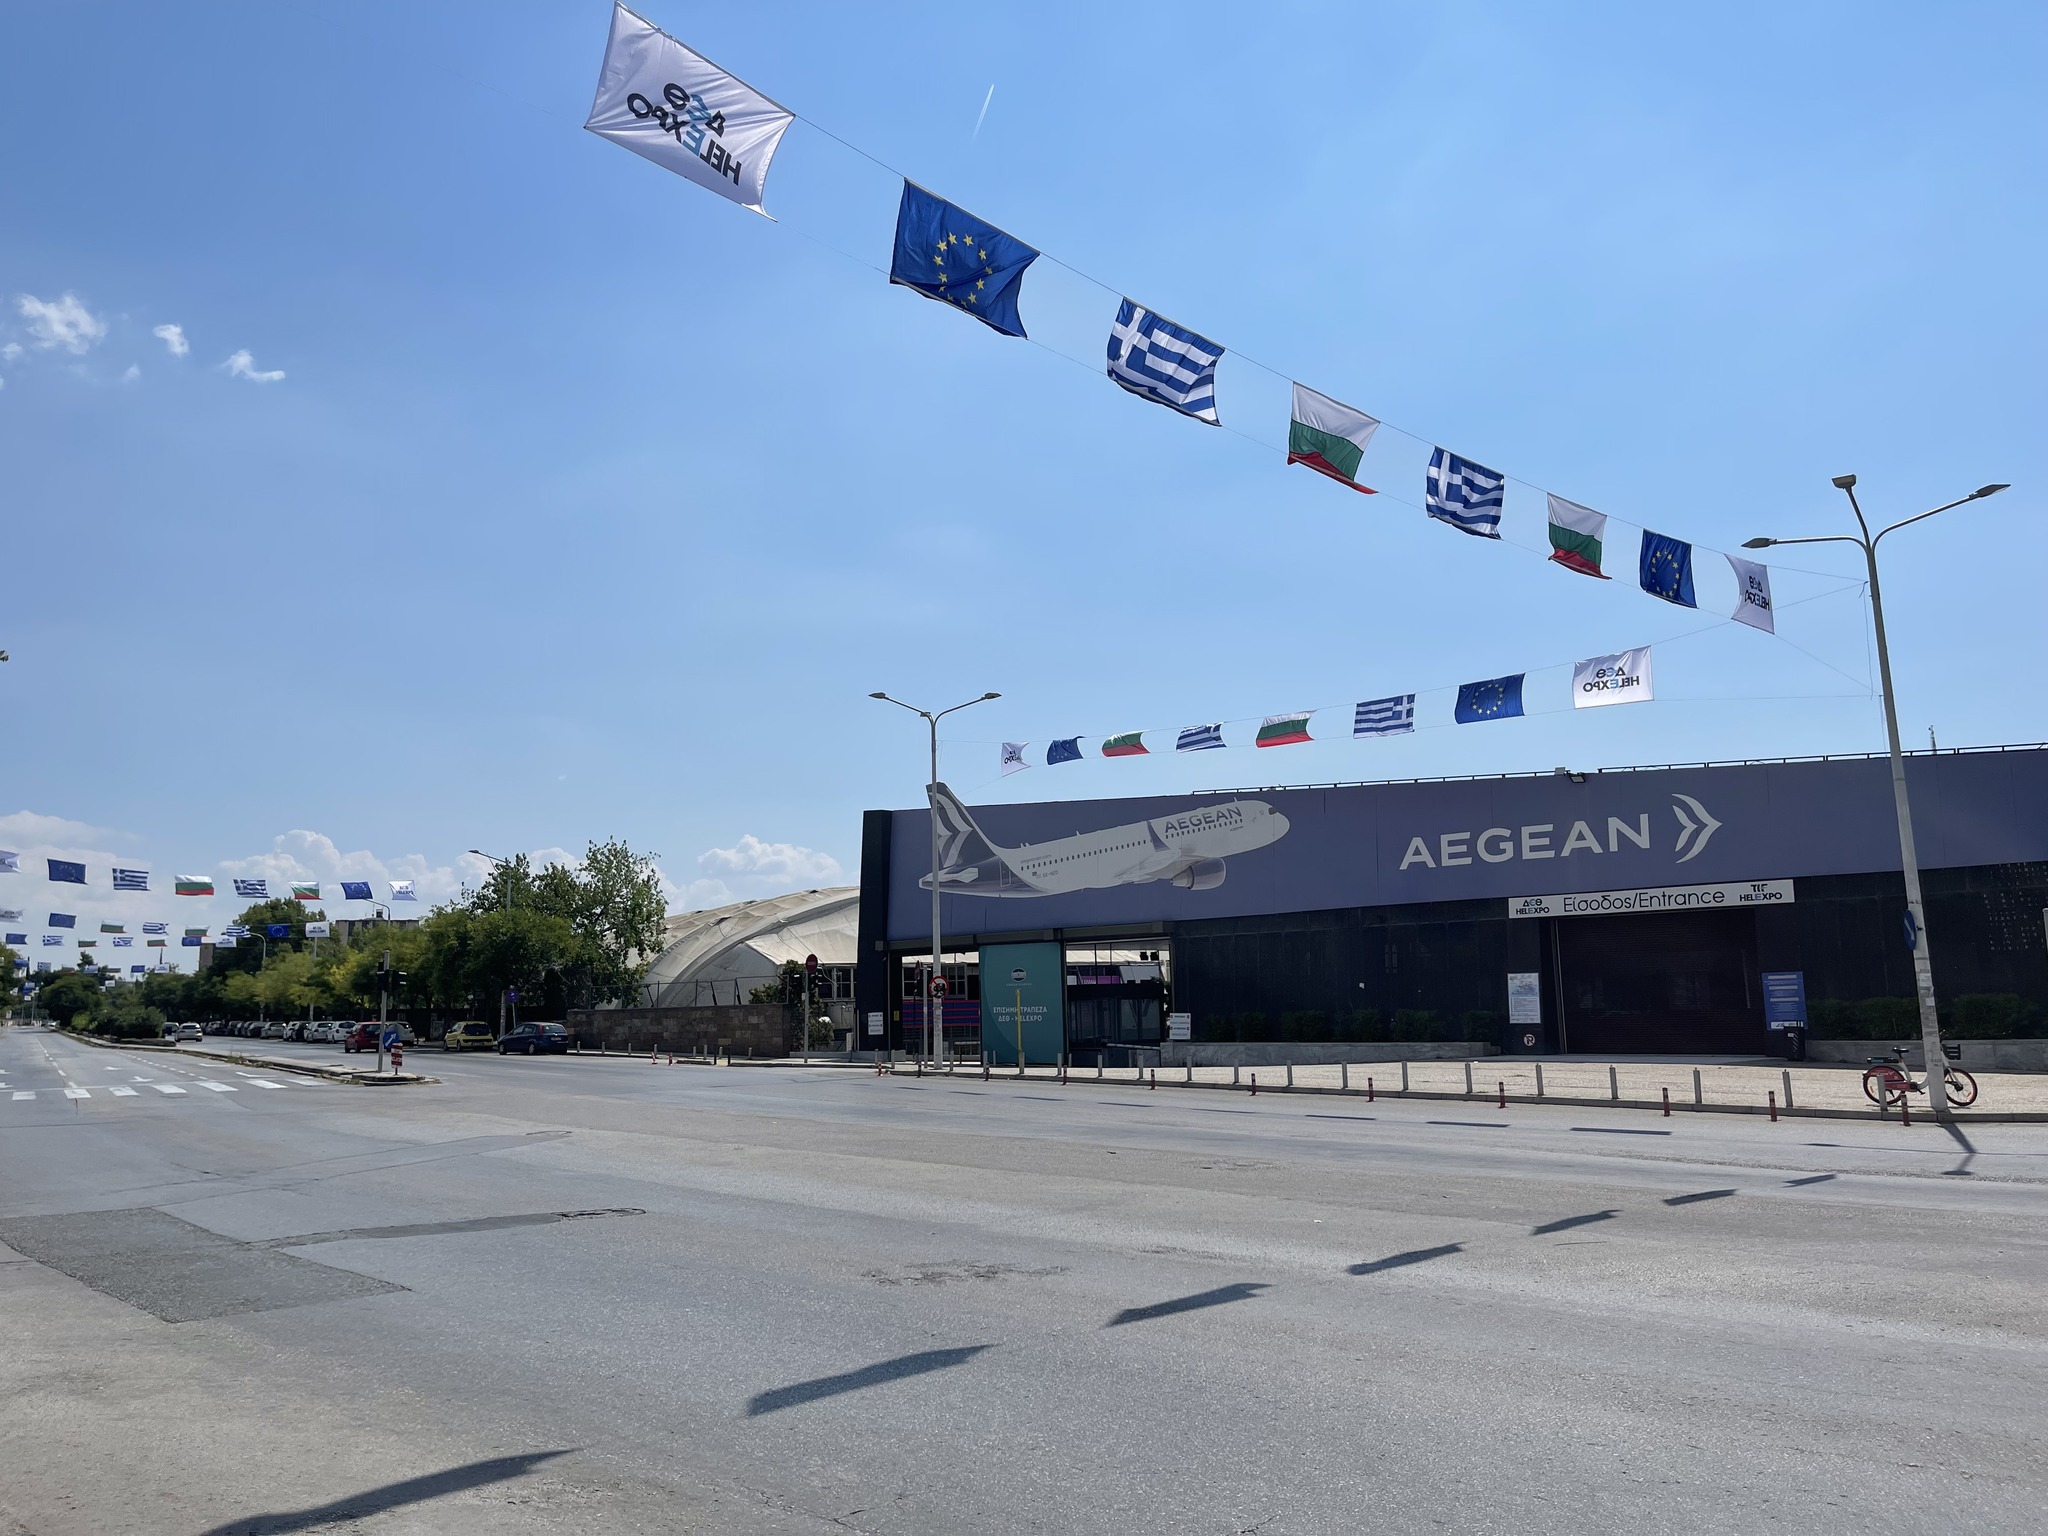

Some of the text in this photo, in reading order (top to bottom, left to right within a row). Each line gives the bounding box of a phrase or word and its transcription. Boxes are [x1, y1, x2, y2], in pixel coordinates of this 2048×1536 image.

[1165, 806, 1242, 833] AEGEAN
[1399, 813, 1650, 870] AEGEAN
[1740, 892, 1782, 902] HELEXPO
[1516, 906, 1550, 915] HELEXPO
